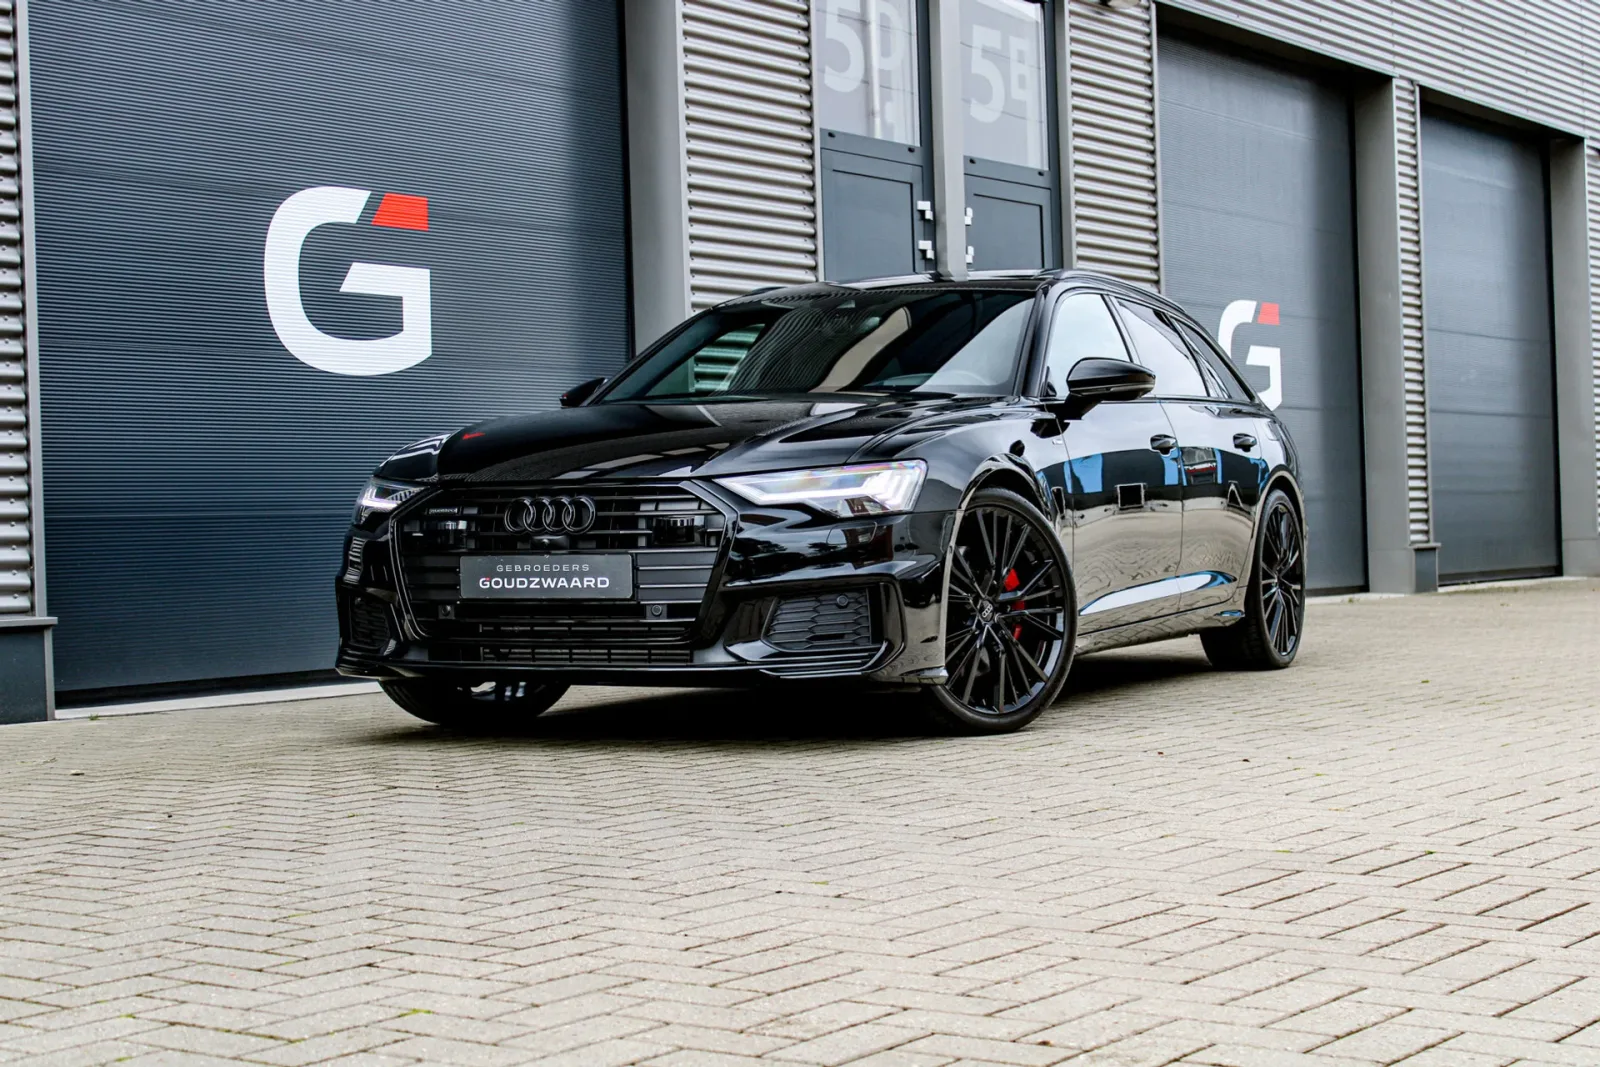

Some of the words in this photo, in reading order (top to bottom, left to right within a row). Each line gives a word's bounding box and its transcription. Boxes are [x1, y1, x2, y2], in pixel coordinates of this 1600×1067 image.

[264, 186, 432, 376] G
[496, 564, 590, 572] GEBROEDERS
[479, 577, 610, 589] GOUDZWAARD
